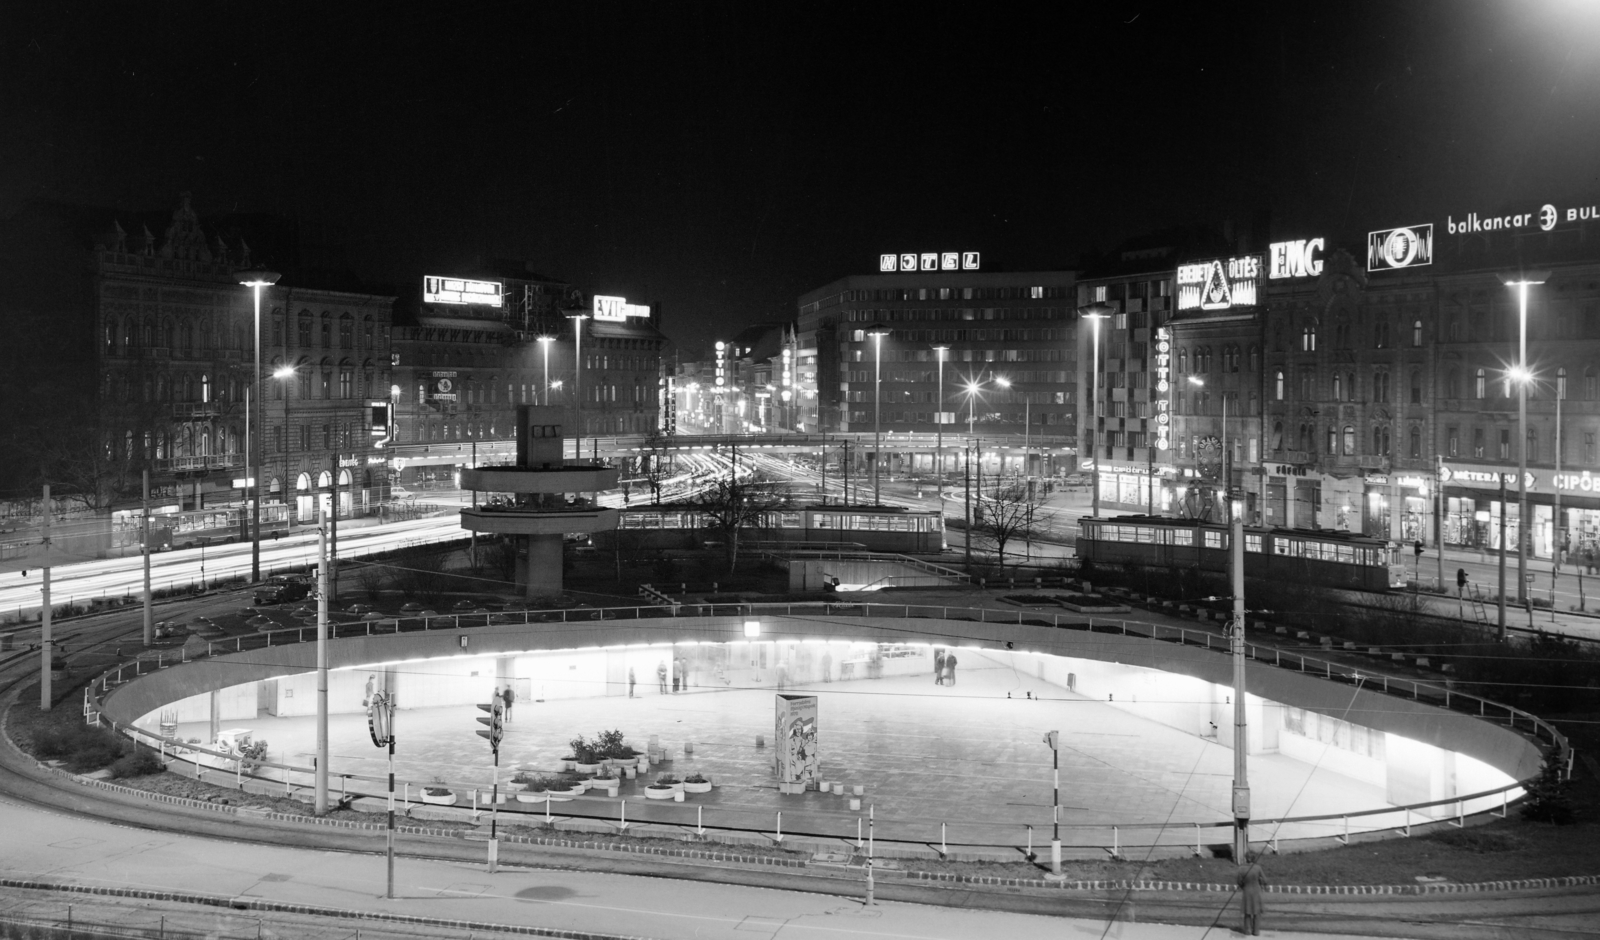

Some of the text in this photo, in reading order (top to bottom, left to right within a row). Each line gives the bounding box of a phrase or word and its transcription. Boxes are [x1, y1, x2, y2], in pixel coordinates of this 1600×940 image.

[1448, 212, 1532, 235] balkancar
[880, 252, 980, 272] HOTEL
[1269, 237, 1325, 280] EMG
[1156, 327, 1170, 451] LOTTO TOTO
